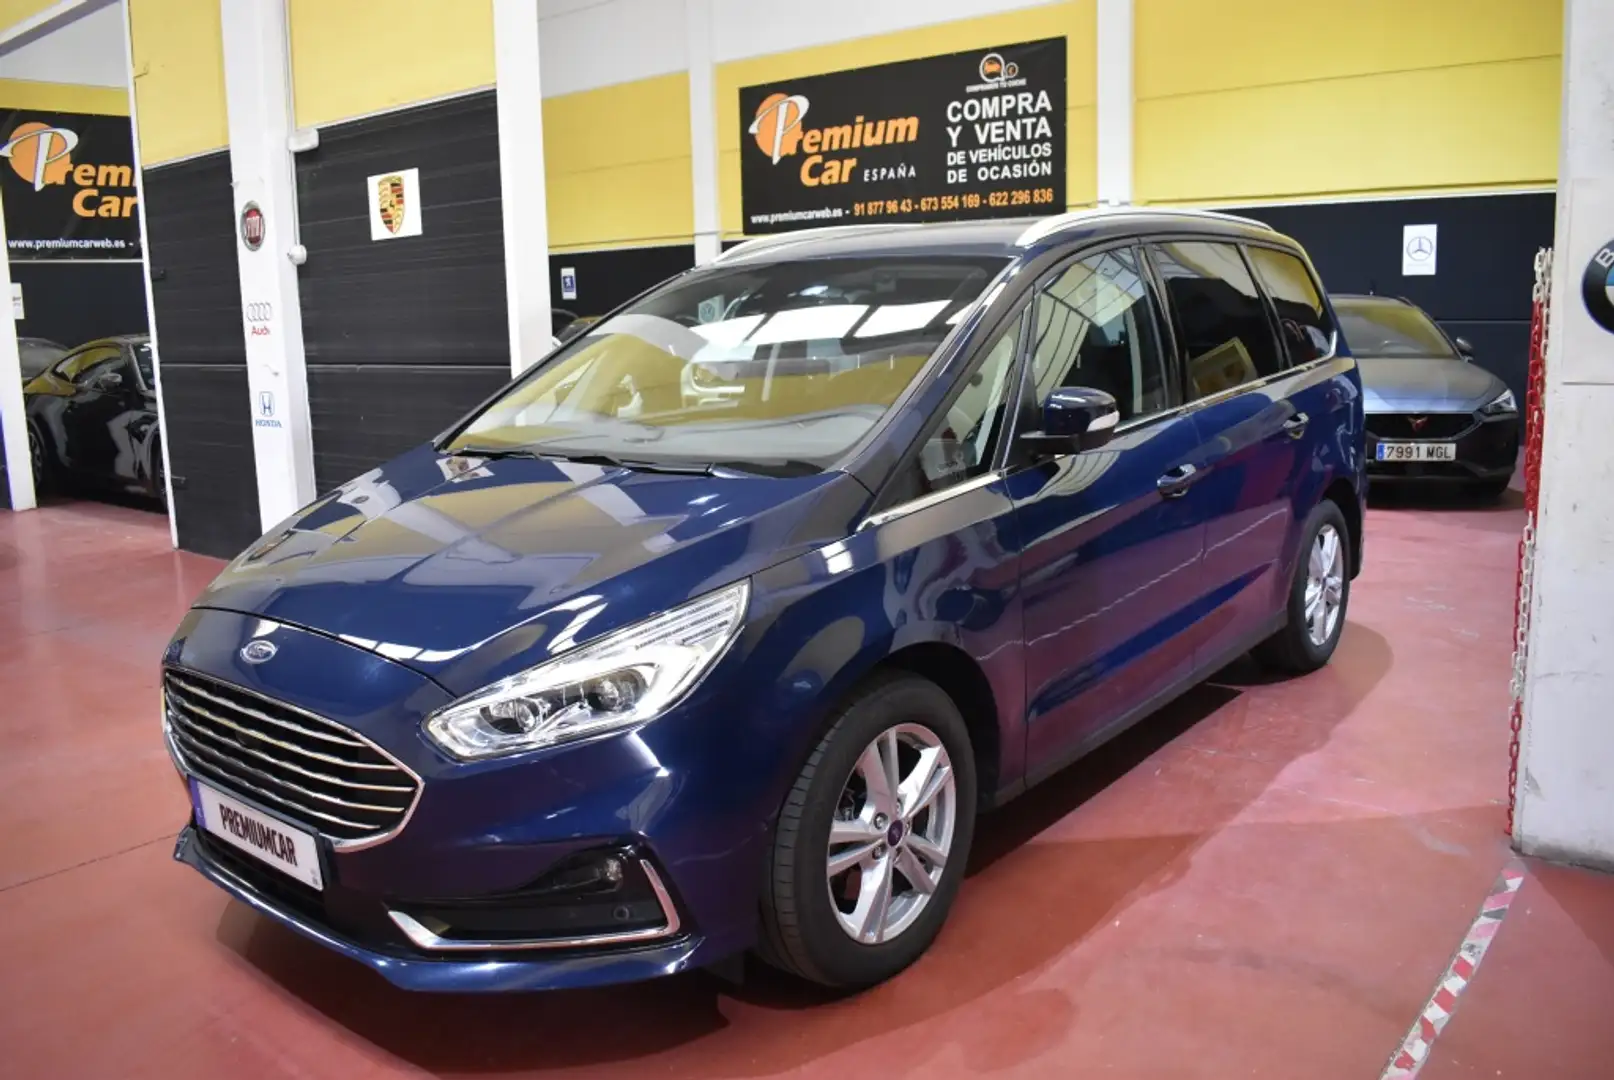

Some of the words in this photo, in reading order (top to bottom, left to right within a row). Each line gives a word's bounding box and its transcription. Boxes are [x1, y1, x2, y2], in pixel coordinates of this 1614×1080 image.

[946, 90, 1052, 123] COMPRA
[748, 95, 919, 165] Premium
[946, 125, 962, 148] Y
[974, 116, 1052, 145] VENTA
[0, 128, 137, 192] Prem
[947, 151, 966, 166] DE
[968, 142, 1052, 164] VEHÍCULOS
[800, 155, 857, 187] Car
[863, 162, 916, 182] ESPAÑA
[947, 168, 967, 184] DE
[977, 159, 1052, 181] OCASIÓN
[72, 188, 138, 218] Car
[750, 207, 842, 224] www.premiumcarweb.es
[854, 202, 865, 216] 91
[867, 201, 884, 216] 877
[900, 199, 912, 213] 43
[920, 197, 938, 212] 673
[941, 196, 959, 210] 554
[989, 191, 1008, 206] 622
[1011, 190, 1030, 205] 296
[1033, 188, 1053, 203] 836
[7, 237, 126, 250] www.premiumcarweb.es
[1386, 446, 1420, 459] 7991
[1426, 446, 1451, 459] MGL
[219, 803, 298, 867] PREMIUMCAR
